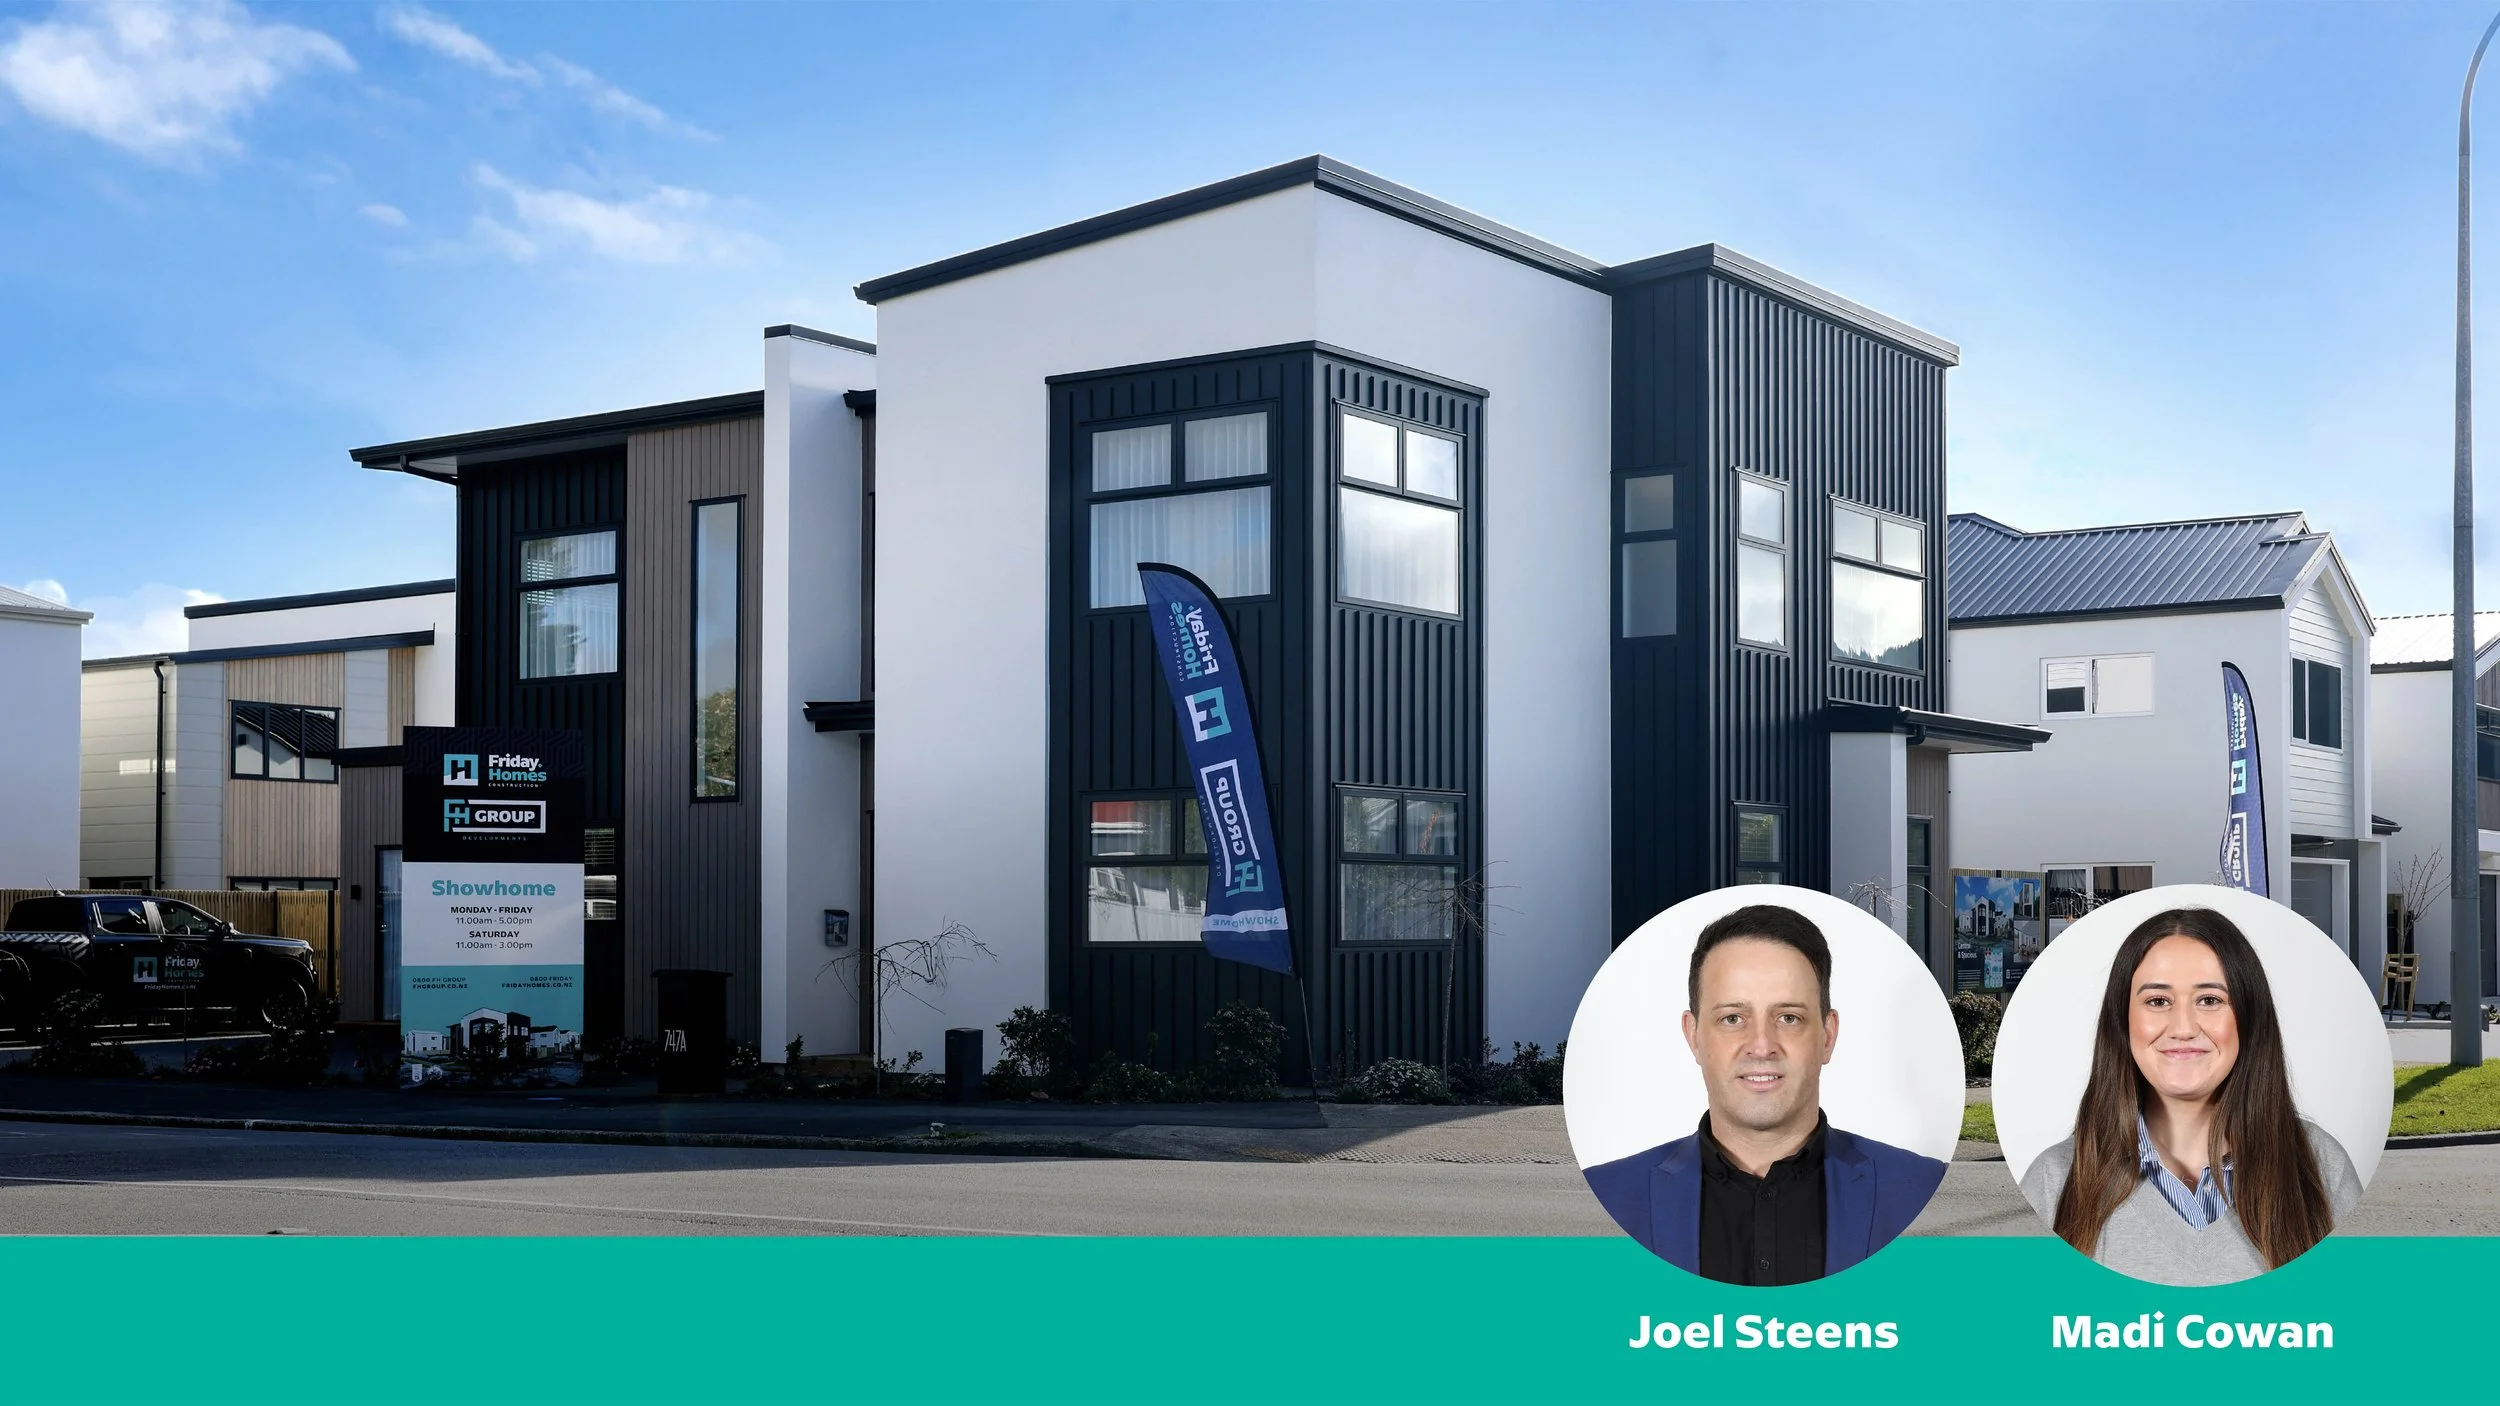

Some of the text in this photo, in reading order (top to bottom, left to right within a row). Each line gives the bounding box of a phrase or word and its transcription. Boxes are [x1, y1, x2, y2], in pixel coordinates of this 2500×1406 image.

[488, 768, 547, 782] Homes
[475, 810, 535, 823] GROUP
[432, 880, 556, 896] Showhome
[450, 906, 492, 914] MONDAY
[499, 906, 533, 914] FRIDAY
[456, 917, 492, 925] 11.00am
[499, 917, 533, 926] 5.00pm
[456, 941, 492, 949] 11.00am
[499, 941, 533, 951] 3.00pm
[664, 1029, 687, 1052] 747A
